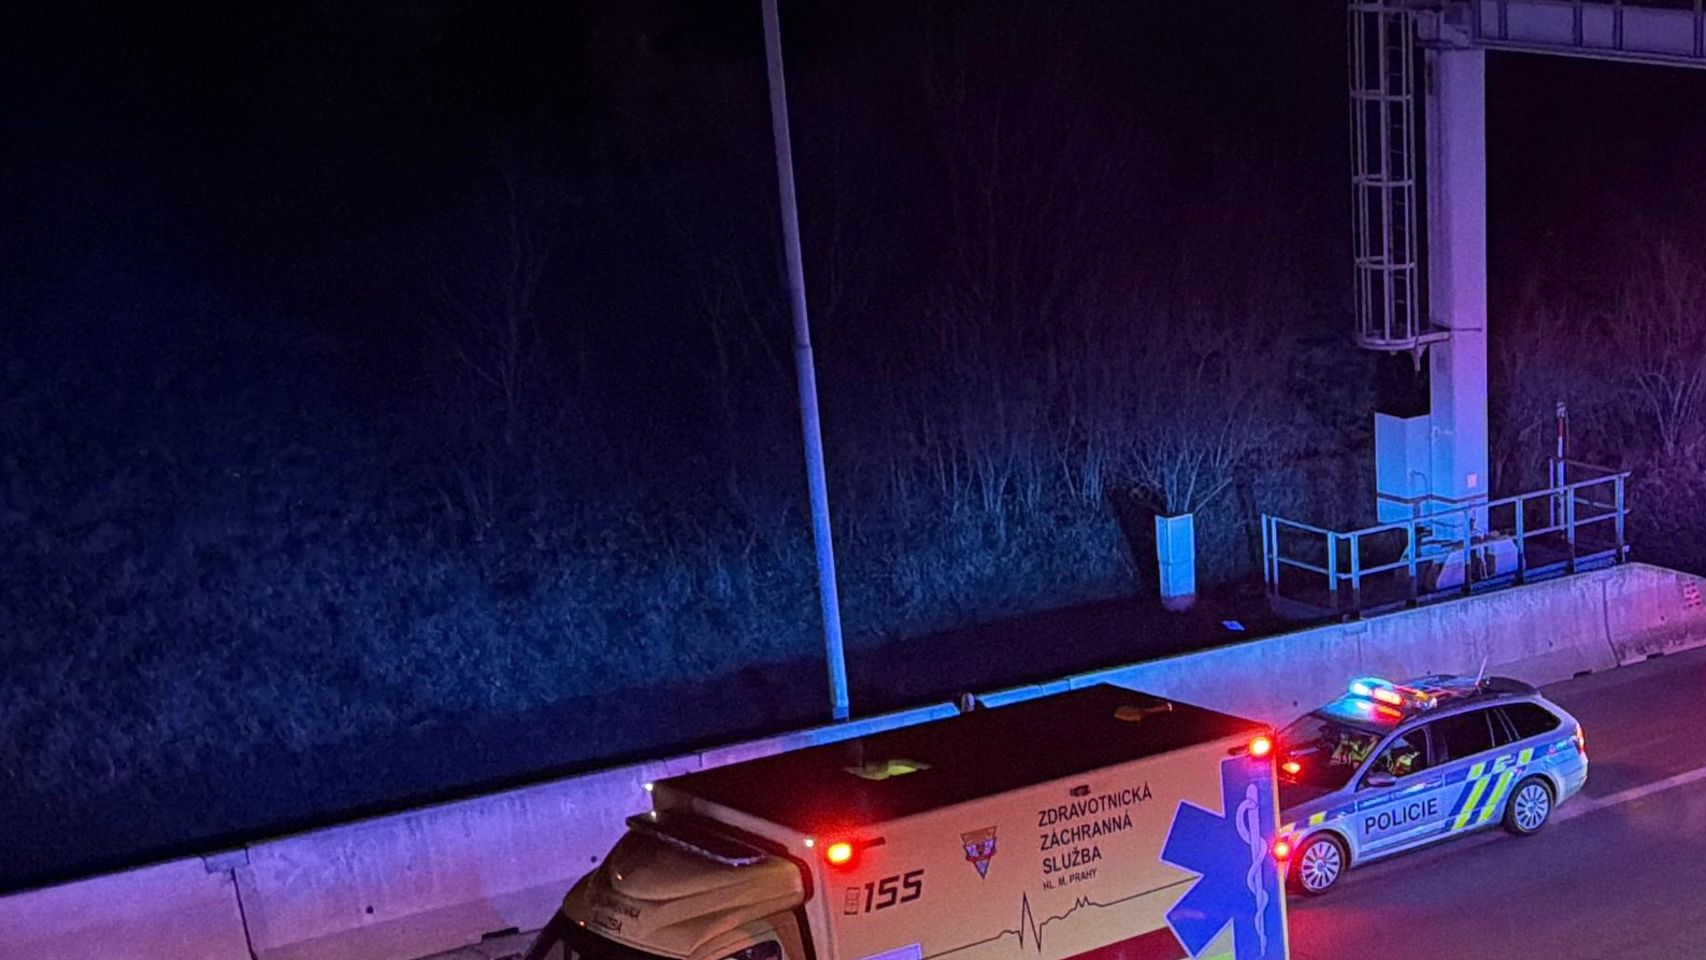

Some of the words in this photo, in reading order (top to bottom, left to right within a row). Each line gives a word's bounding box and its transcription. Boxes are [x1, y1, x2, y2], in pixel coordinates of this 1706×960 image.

[1038, 780, 1152, 827] ZDRAVOTNICKÁ
[1364, 798, 1438, 835] POLICIE
[1040, 809, 1133, 851] ZÁCHRANNÁ
[1043, 846, 1102, 874] SLUŽBA
[1069, 868, 1098, 885] PRAHY
[864, 869, 925, 914] 155
